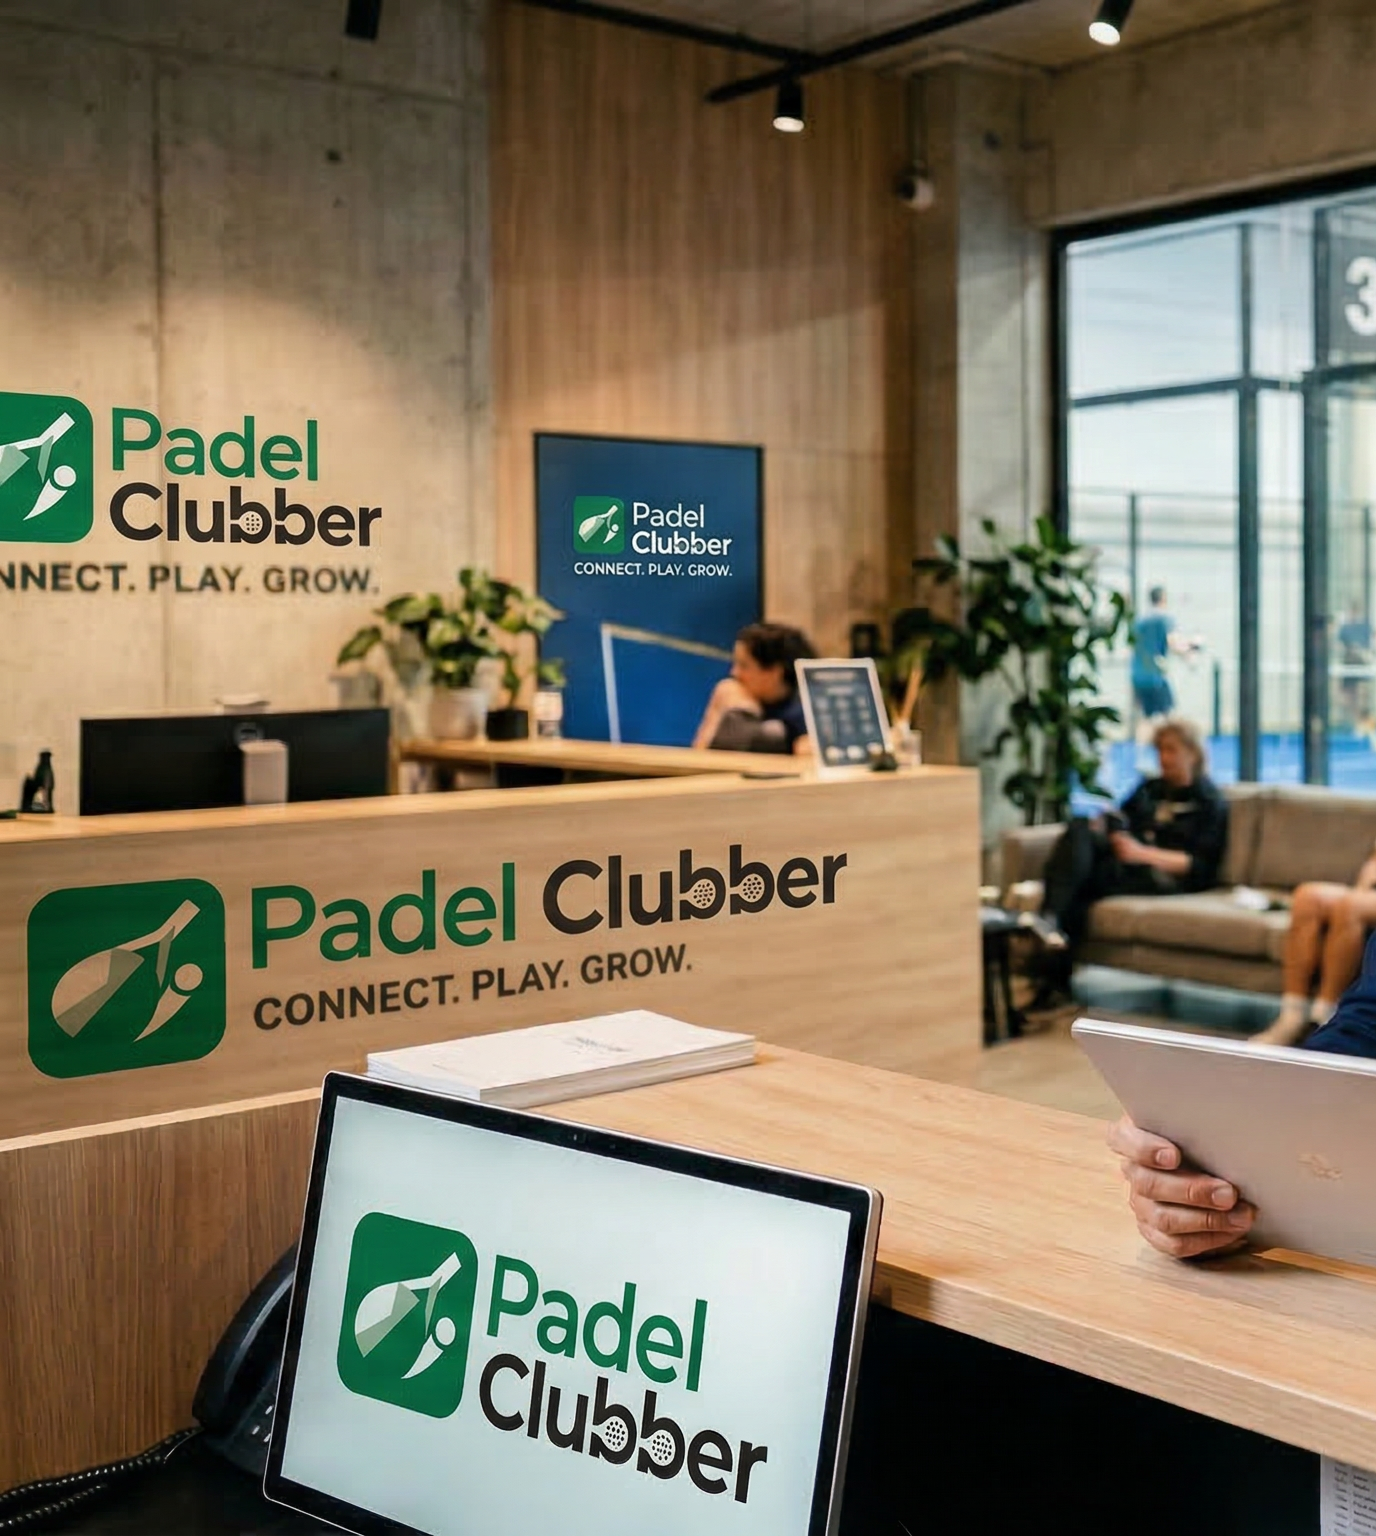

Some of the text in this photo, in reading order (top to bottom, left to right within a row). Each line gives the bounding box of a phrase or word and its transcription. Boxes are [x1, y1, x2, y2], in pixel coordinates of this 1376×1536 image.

[112, 407, 318, 481] Padel
[109, 482, 383, 547] Clubber
[631, 530, 733, 556] Clubber
[632, 501, 705, 528] Padel
[148, 563, 250, 593] PLAY.
[262, 565, 380, 595] GROW.
[574, 562, 733, 577] CONNECT. PLAY. GROW.
[251, 844, 848, 969] Padel Clubber
[252, 942, 693, 1032] CONNECT. PLAY. GROW.
[486, 1253, 709, 1393] Padel
[479, 1352, 769, 1504] Clubber
